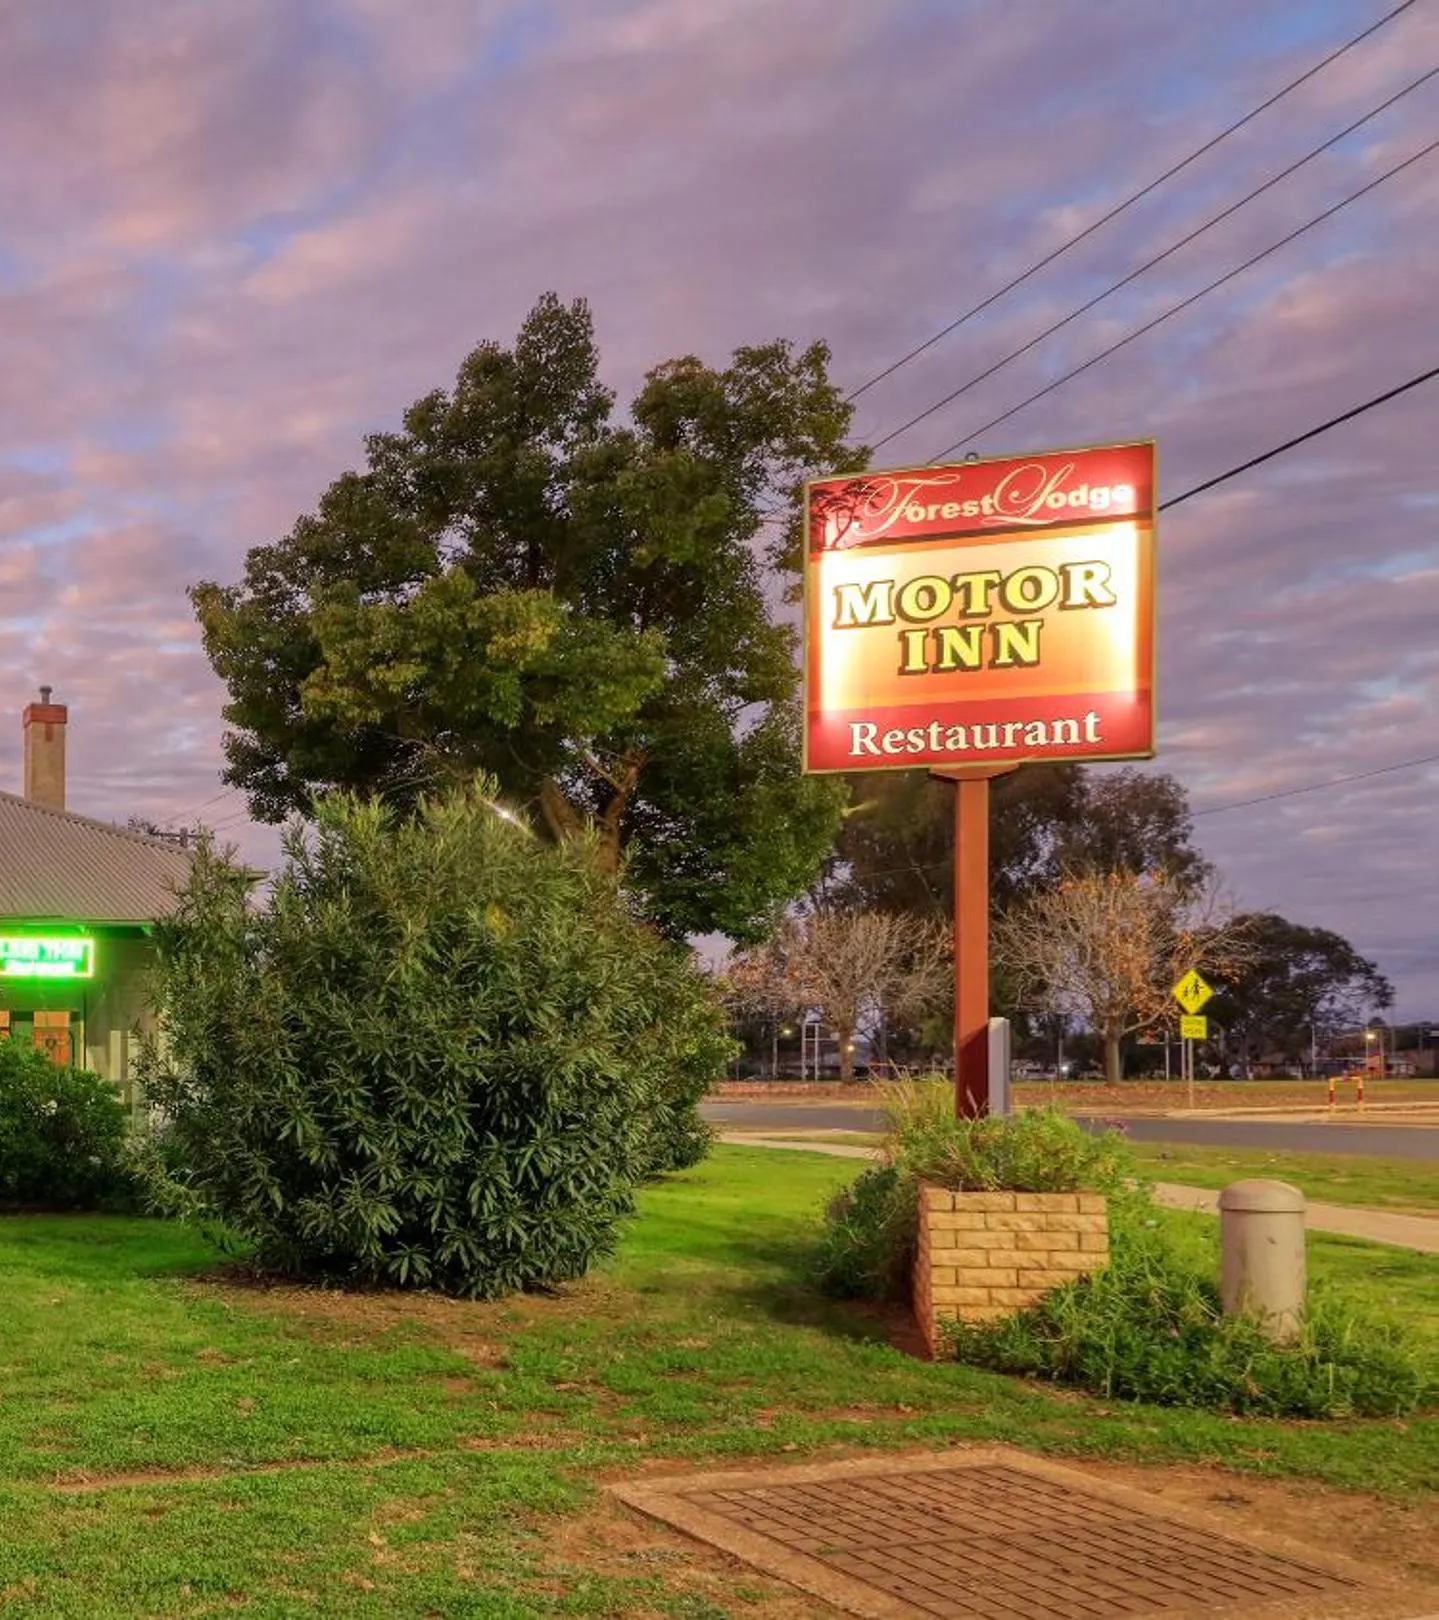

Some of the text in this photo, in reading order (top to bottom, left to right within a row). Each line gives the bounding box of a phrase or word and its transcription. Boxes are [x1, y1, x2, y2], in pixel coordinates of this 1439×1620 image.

[853, 463, 1136, 536] Forest Lodge
[831, 560, 1117, 630] MOTOR
[897, 619, 1044, 676] INN
[847, 711, 1104, 757] Restaurant
